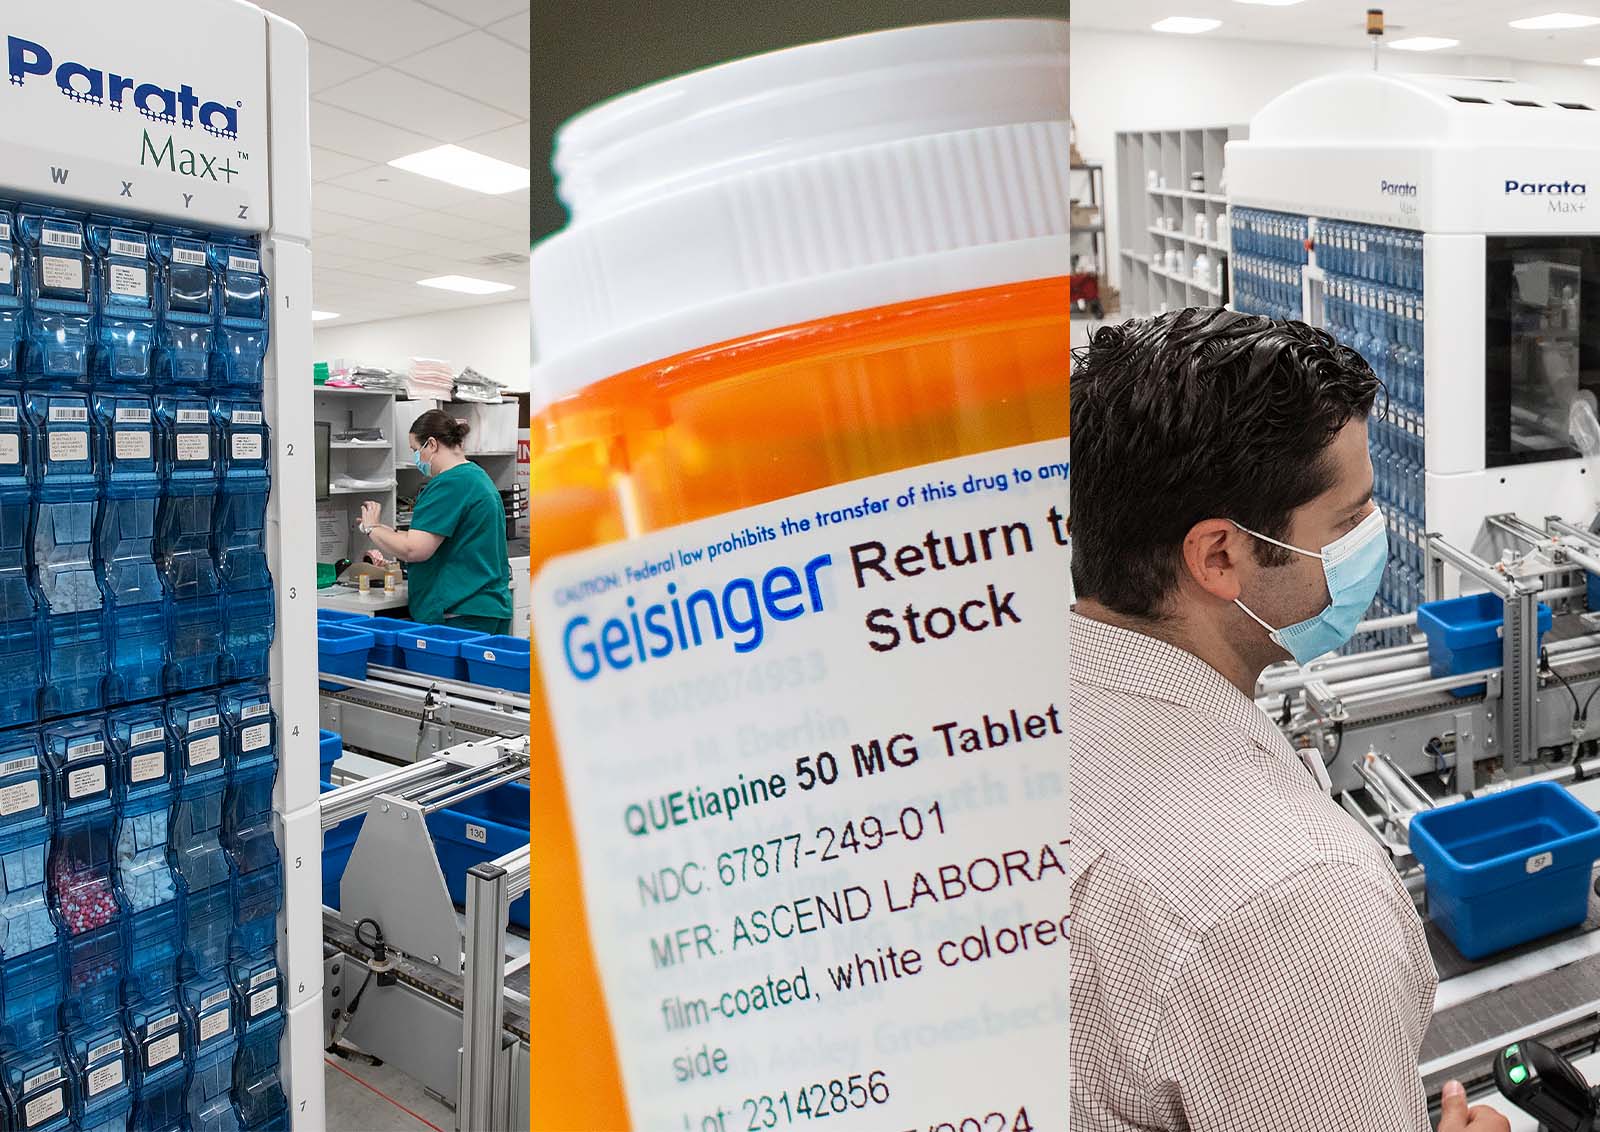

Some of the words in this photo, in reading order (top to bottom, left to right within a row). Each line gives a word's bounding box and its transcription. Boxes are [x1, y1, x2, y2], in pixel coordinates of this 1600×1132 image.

[51, 168, 69, 185] W
[120, 181, 133, 198] X
[182, 193, 194, 208] Y
[238, 205, 249, 219] Z
[1505, 180, 1587, 196] Parata
[284, 295, 290, 309] 1
[287, 443, 294, 457] 2
[625, 553, 676, 584] Federal
[677, 549, 703, 567] law
[707, 524, 776, 563] prohibits
[780, 516, 811, 536] the
[815, 495, 889, 528] transfer
[896, 488, 916, 509] of
[921, 475, 957, 500] this
[962, 469, 1008, 493] drug
[1011, 468, 1032, 484] to
[1038, 462, 1069, 480] any
[850, 521, 1033, 588] Return
[1046, 505, 1070, 546] t
[289, 586, 297, 600] 3
[562, 552, 833, 682] Geisinger
[865, 584, 1021, 652] Stock
[292, 725, 300, 737] 4
[624, 774, 787, 837] QUEtiapine
[796, 751, 839, 791] 50
[852, 732, 919, 778] MG
[932, 703, 1063, 757] Tablet
[470, 828, 484, 839] 130
[295, 856, 302, 870] 5
[637, 861, 711, 906] NDC:
[717, 800, 945, 886] 67877-249-01
[1535, 857, 1546, 868] 57
[649, 925, 722, 969] MFR:
[731, 886, 873, 951] ASCEND
[298, 982, 305, 994] 6
[660, 970, 820, 1031] film-coated,
[829, 941, 922, 991] white
[672, 1045, 729, 1082] side
[299, 1099, 307, 1113] 7
[743, 1069, 890, 1130] 23142856
